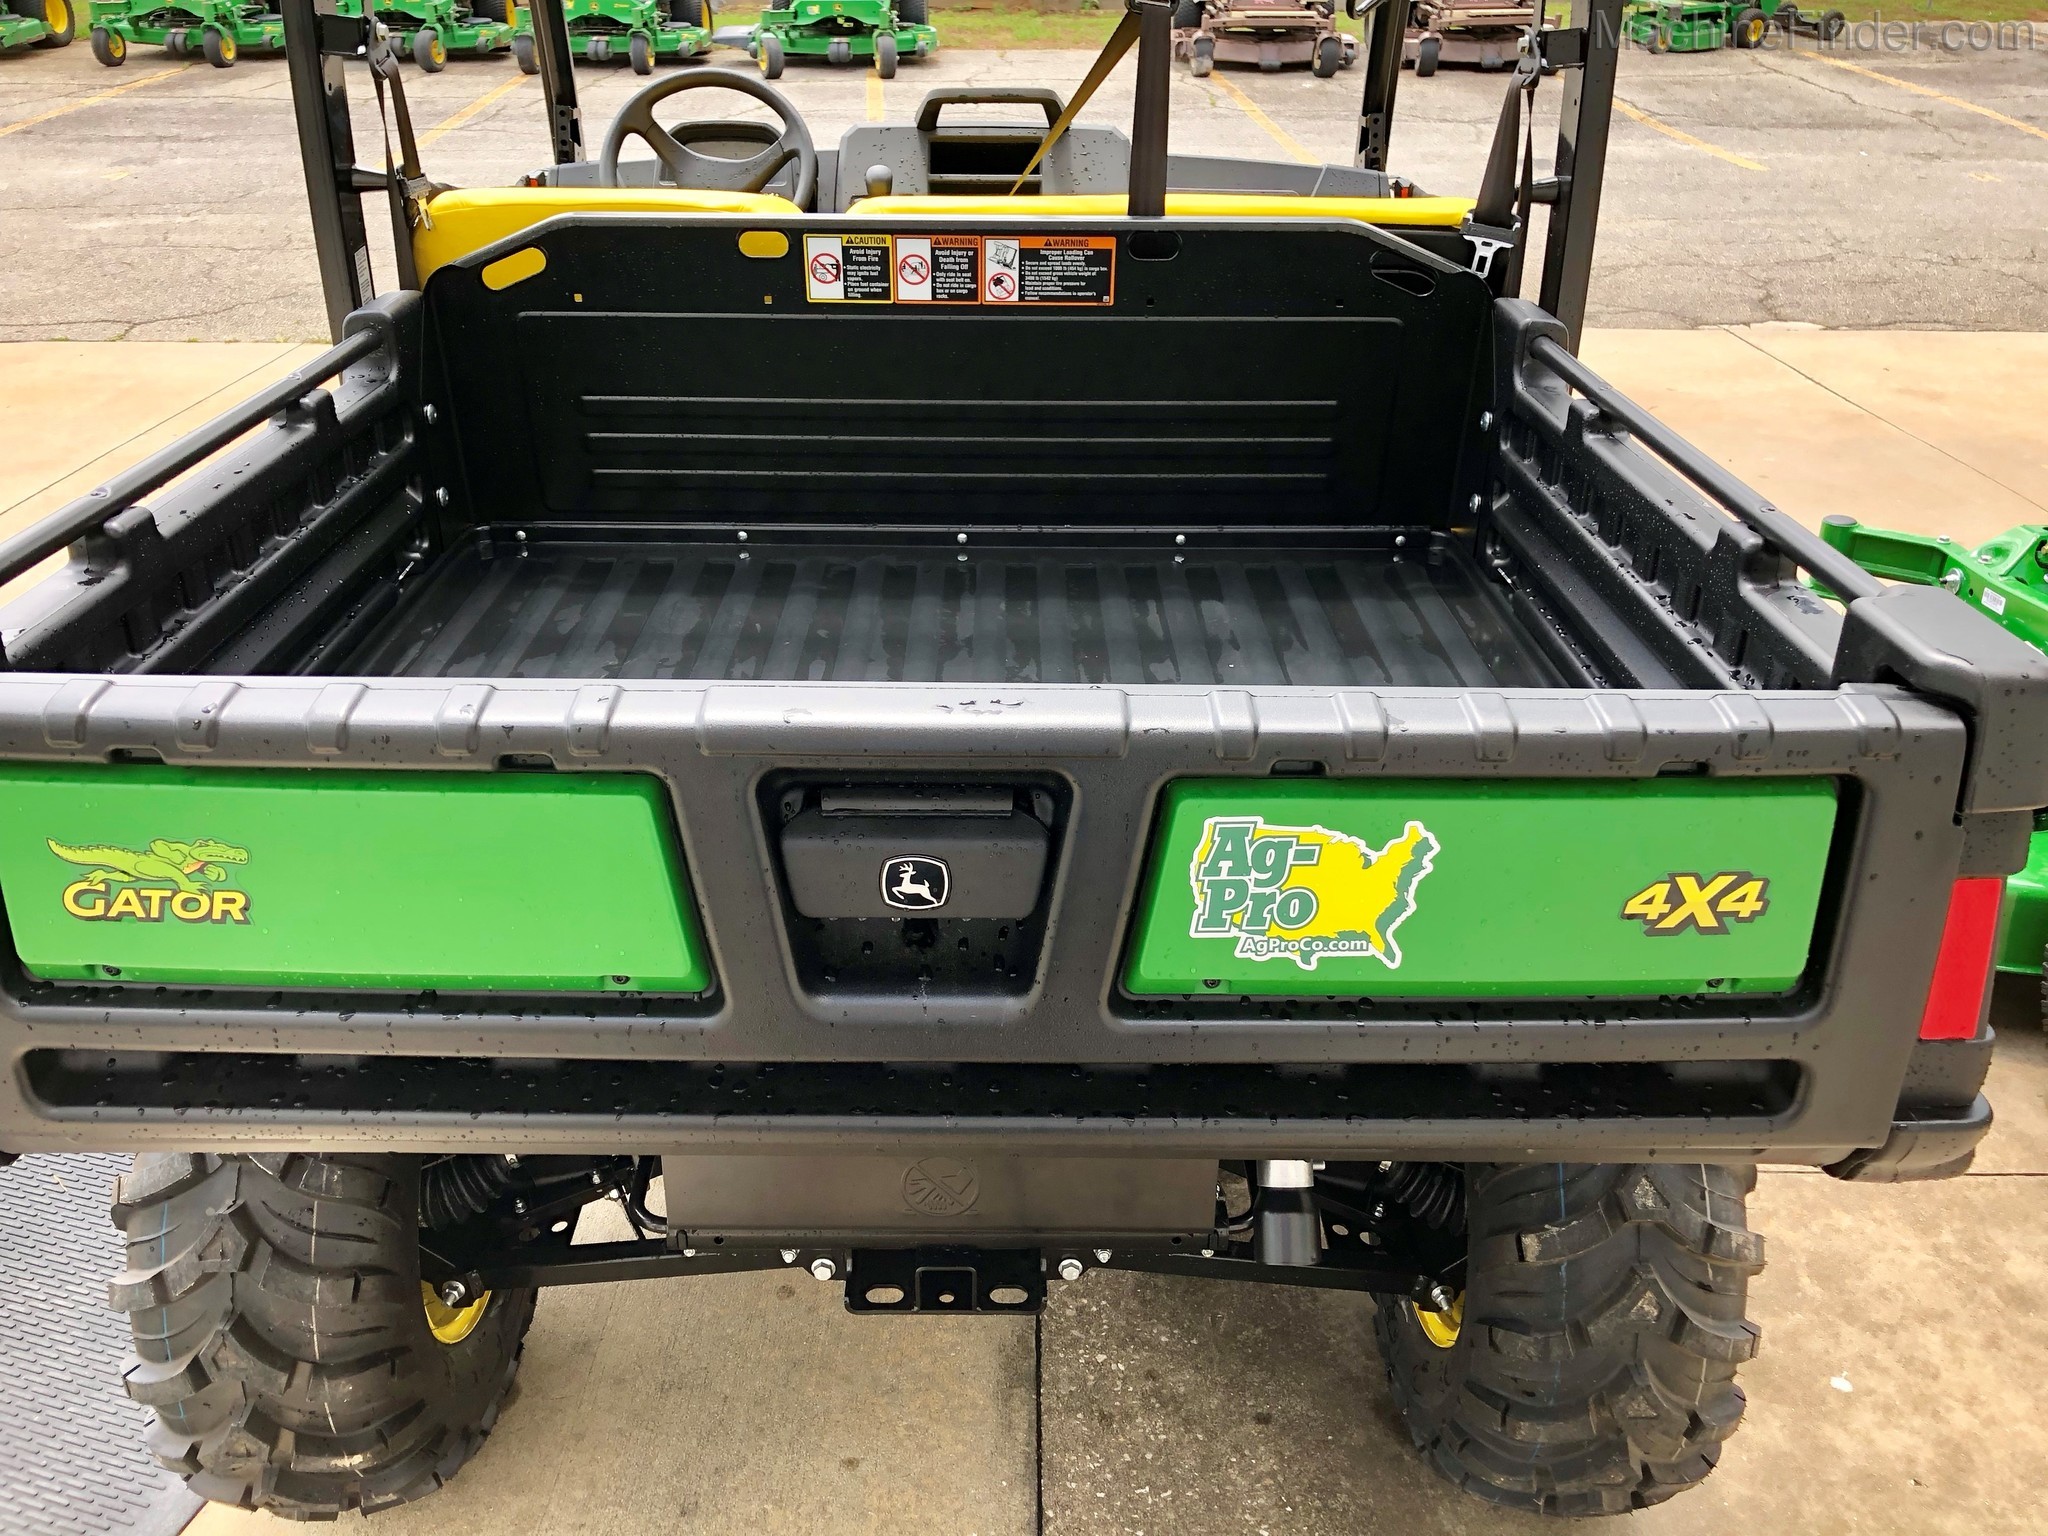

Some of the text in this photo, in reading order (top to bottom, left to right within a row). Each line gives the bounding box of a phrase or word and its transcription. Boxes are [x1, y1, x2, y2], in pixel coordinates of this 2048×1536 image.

[854, 236, 887, 245] CAUTION
[942, 238, 978, 246] WARNING
[1052, 238, 1089, 248] WARNING
[866, 248, 881, 256] Injury
[951, 249, 967, 257] Injury
[940, 263, 960, 271] Falling
[1198, 822, 1321, 889] Ag-
[62, 880, 251, 924] GATOR
[1196, 878, 1319, 933] Pro
[1621, 872, 1769, 934] 4X4
[1241, 936, 1370, 956] AgProCo.com
